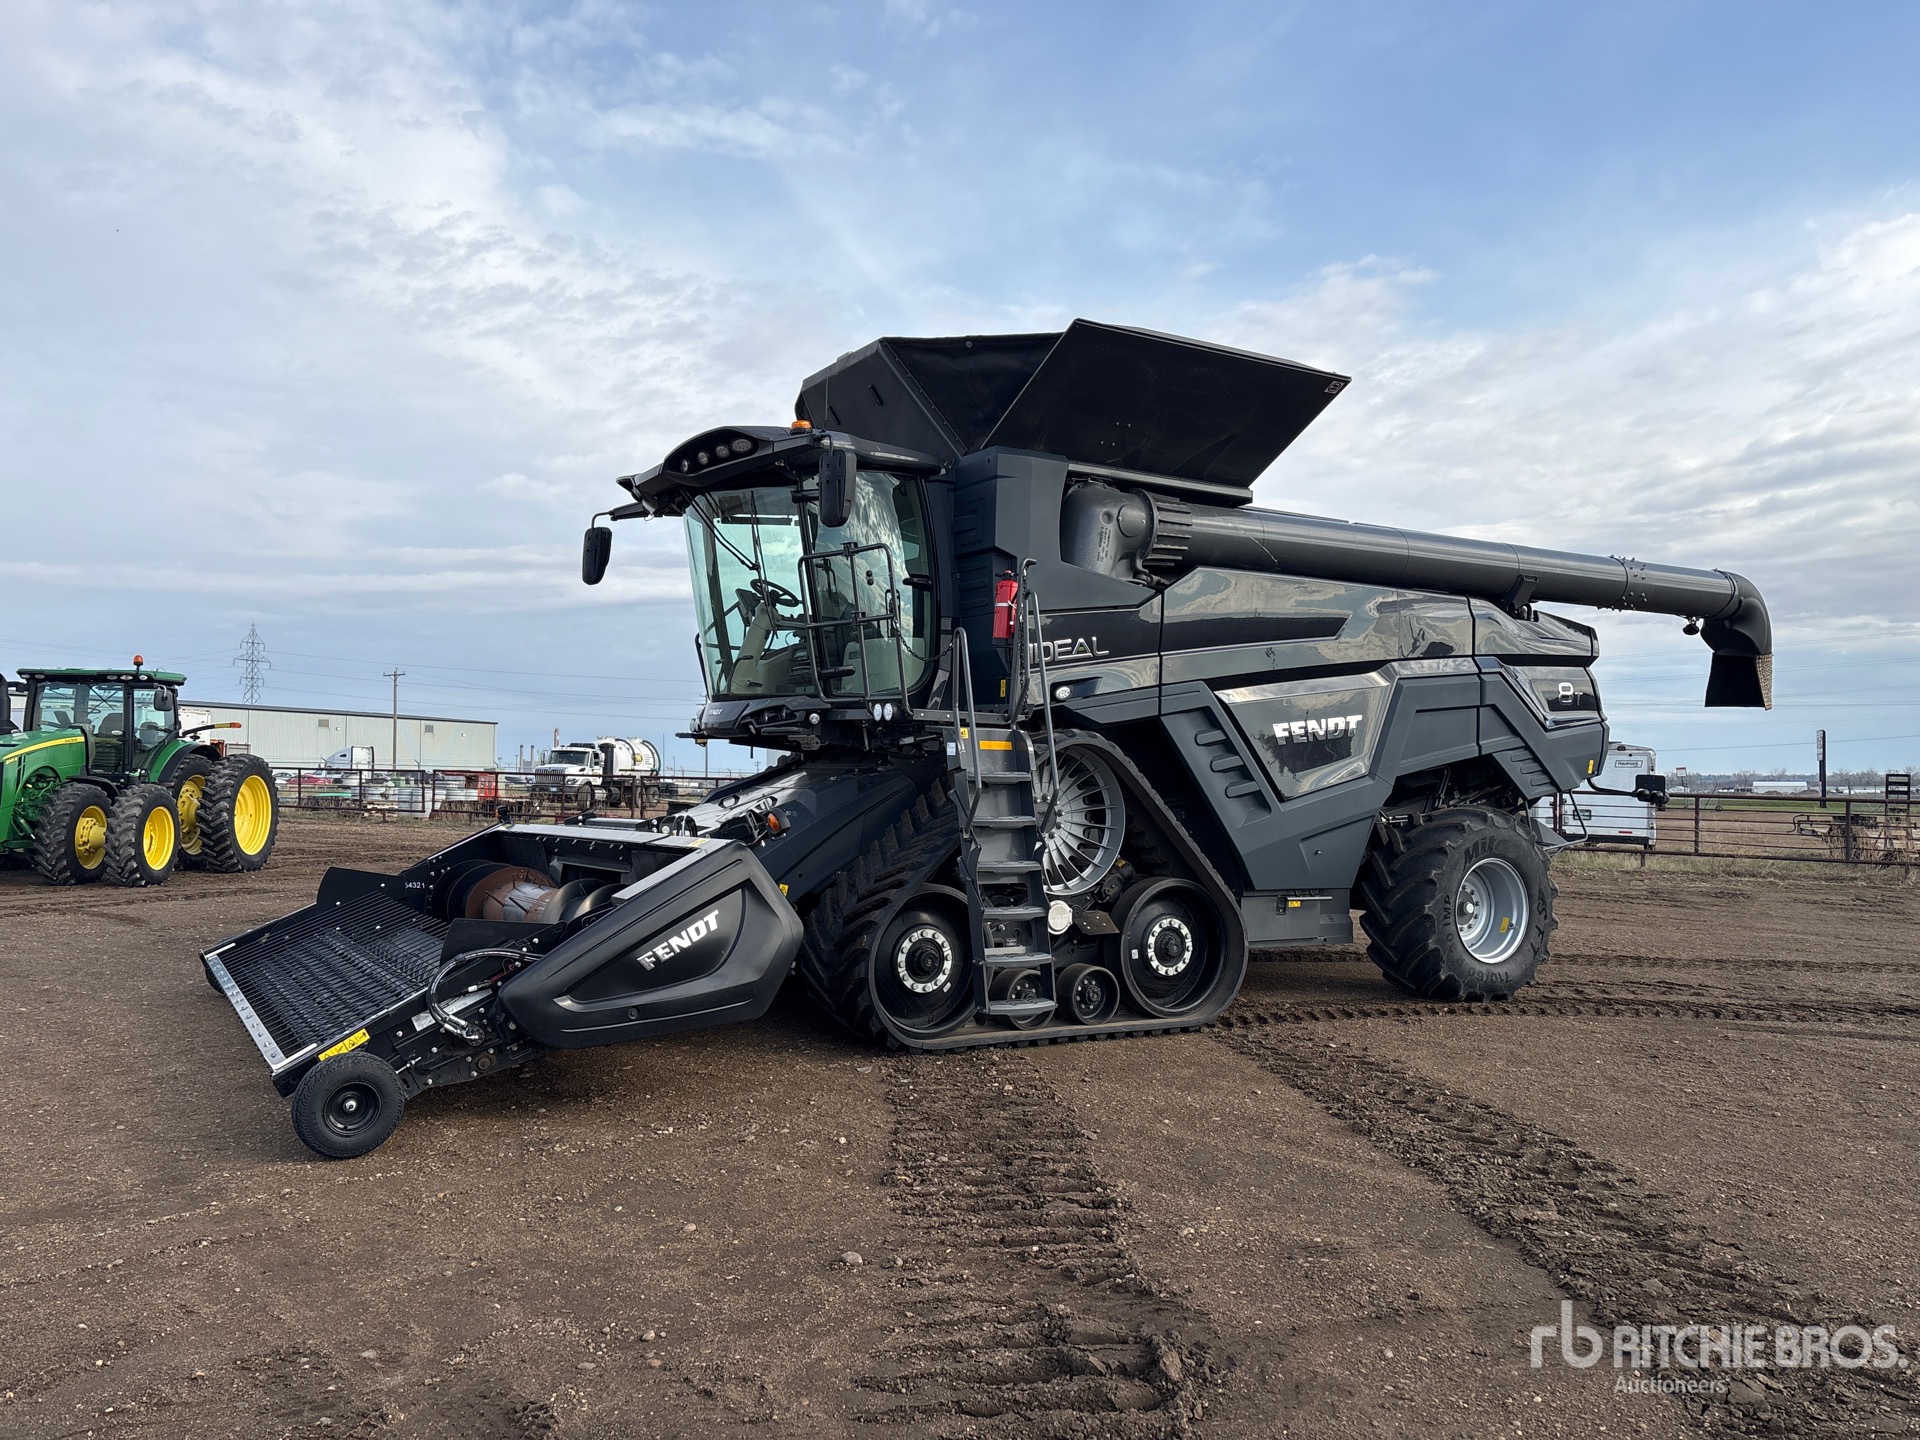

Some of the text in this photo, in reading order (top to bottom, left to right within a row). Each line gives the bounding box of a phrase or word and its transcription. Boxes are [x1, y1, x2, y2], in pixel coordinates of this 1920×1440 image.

[1028, 636, 1110, 664] IDEAL
[1272, 714, 1363, 746] FENDT
[637, 909, 719, 971] FENDT
